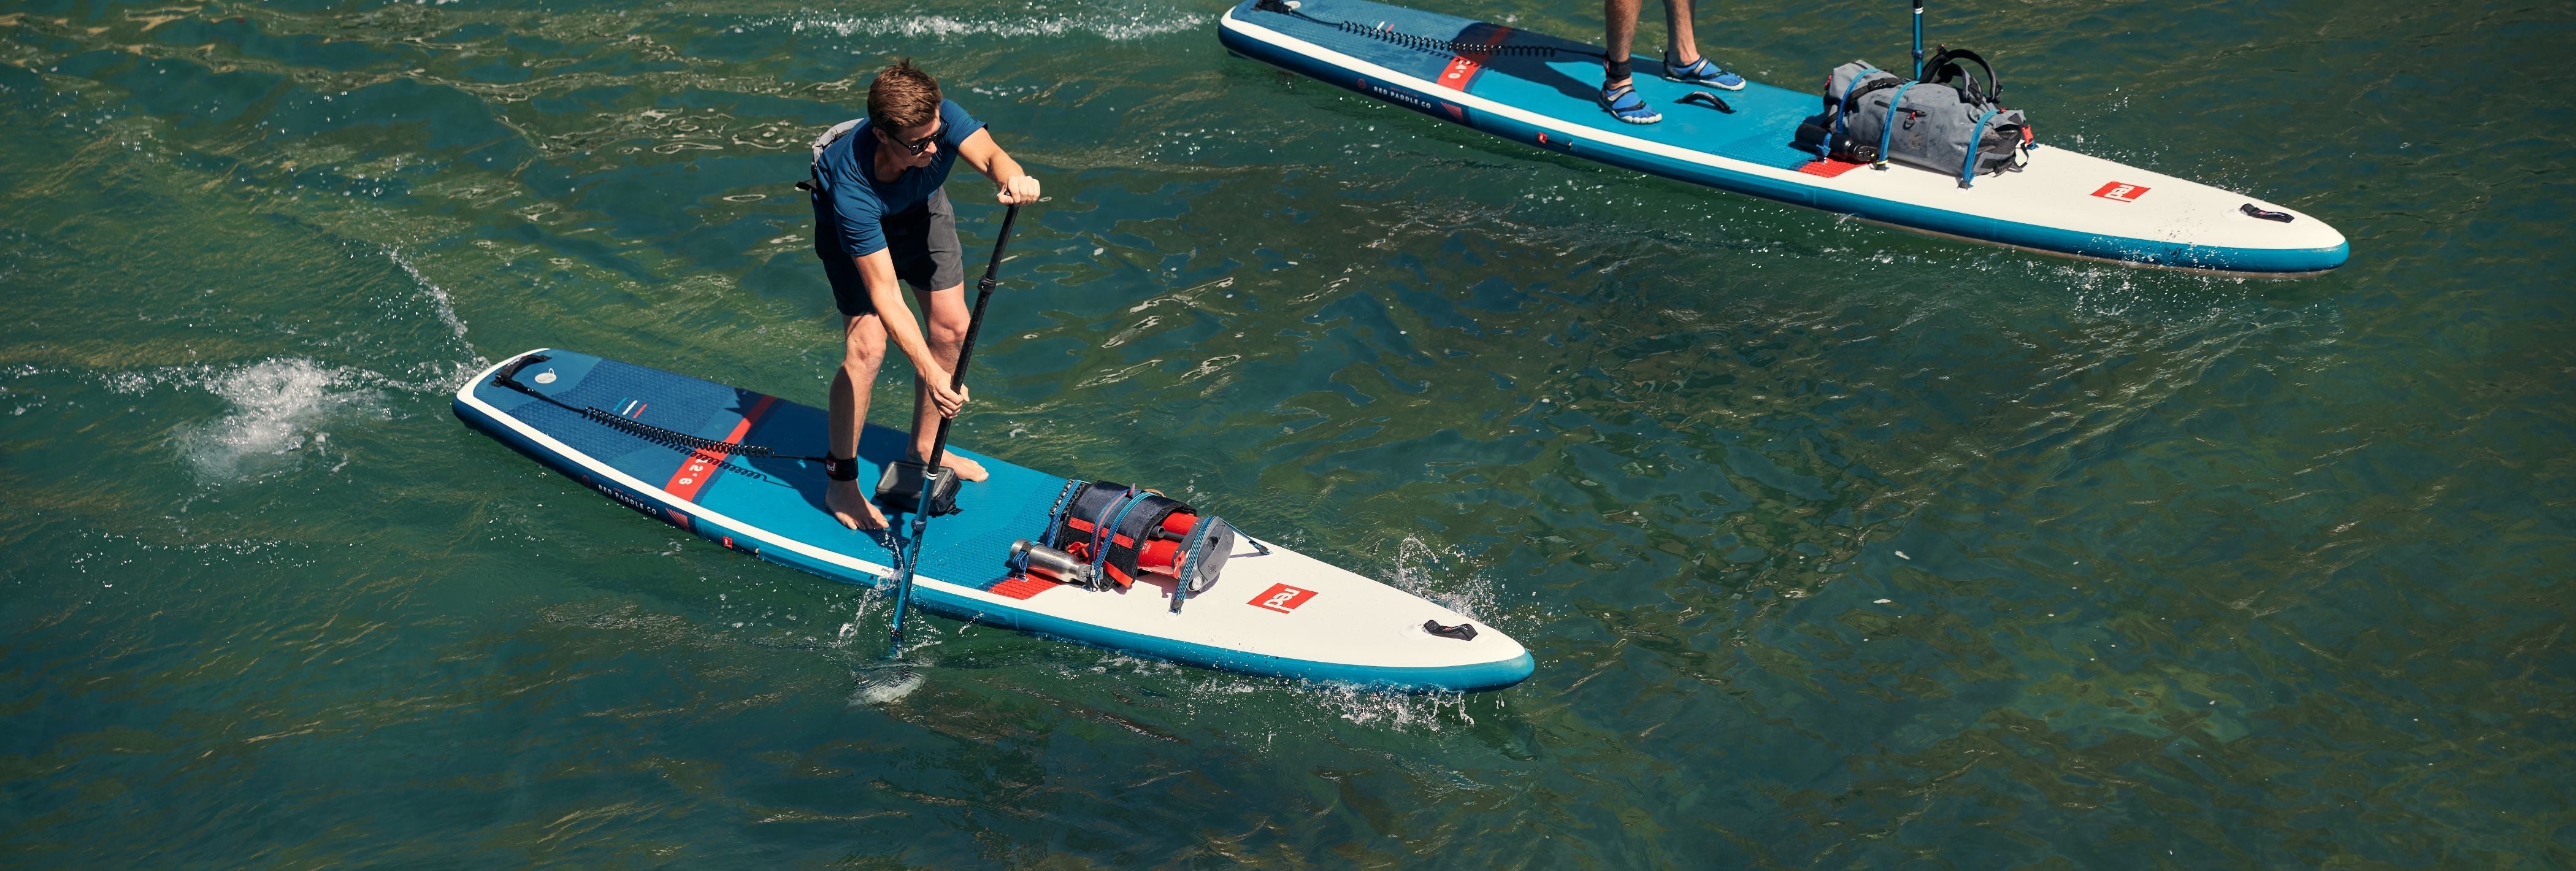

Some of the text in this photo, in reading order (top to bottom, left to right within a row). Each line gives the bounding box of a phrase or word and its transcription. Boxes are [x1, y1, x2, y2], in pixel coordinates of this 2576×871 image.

[1374, 86, 1387, 95] RED
[1390, 91, 1419, 105] PADDLE
[2104, 184, 2134, 201] red
[826, 462, 835, 472] red
[599, 484, 612, 495] RED
[615, 492, 644, 510] PADDLE
[647, 506, 657, 515] CO
[1262, 588, 1301, 612] red
